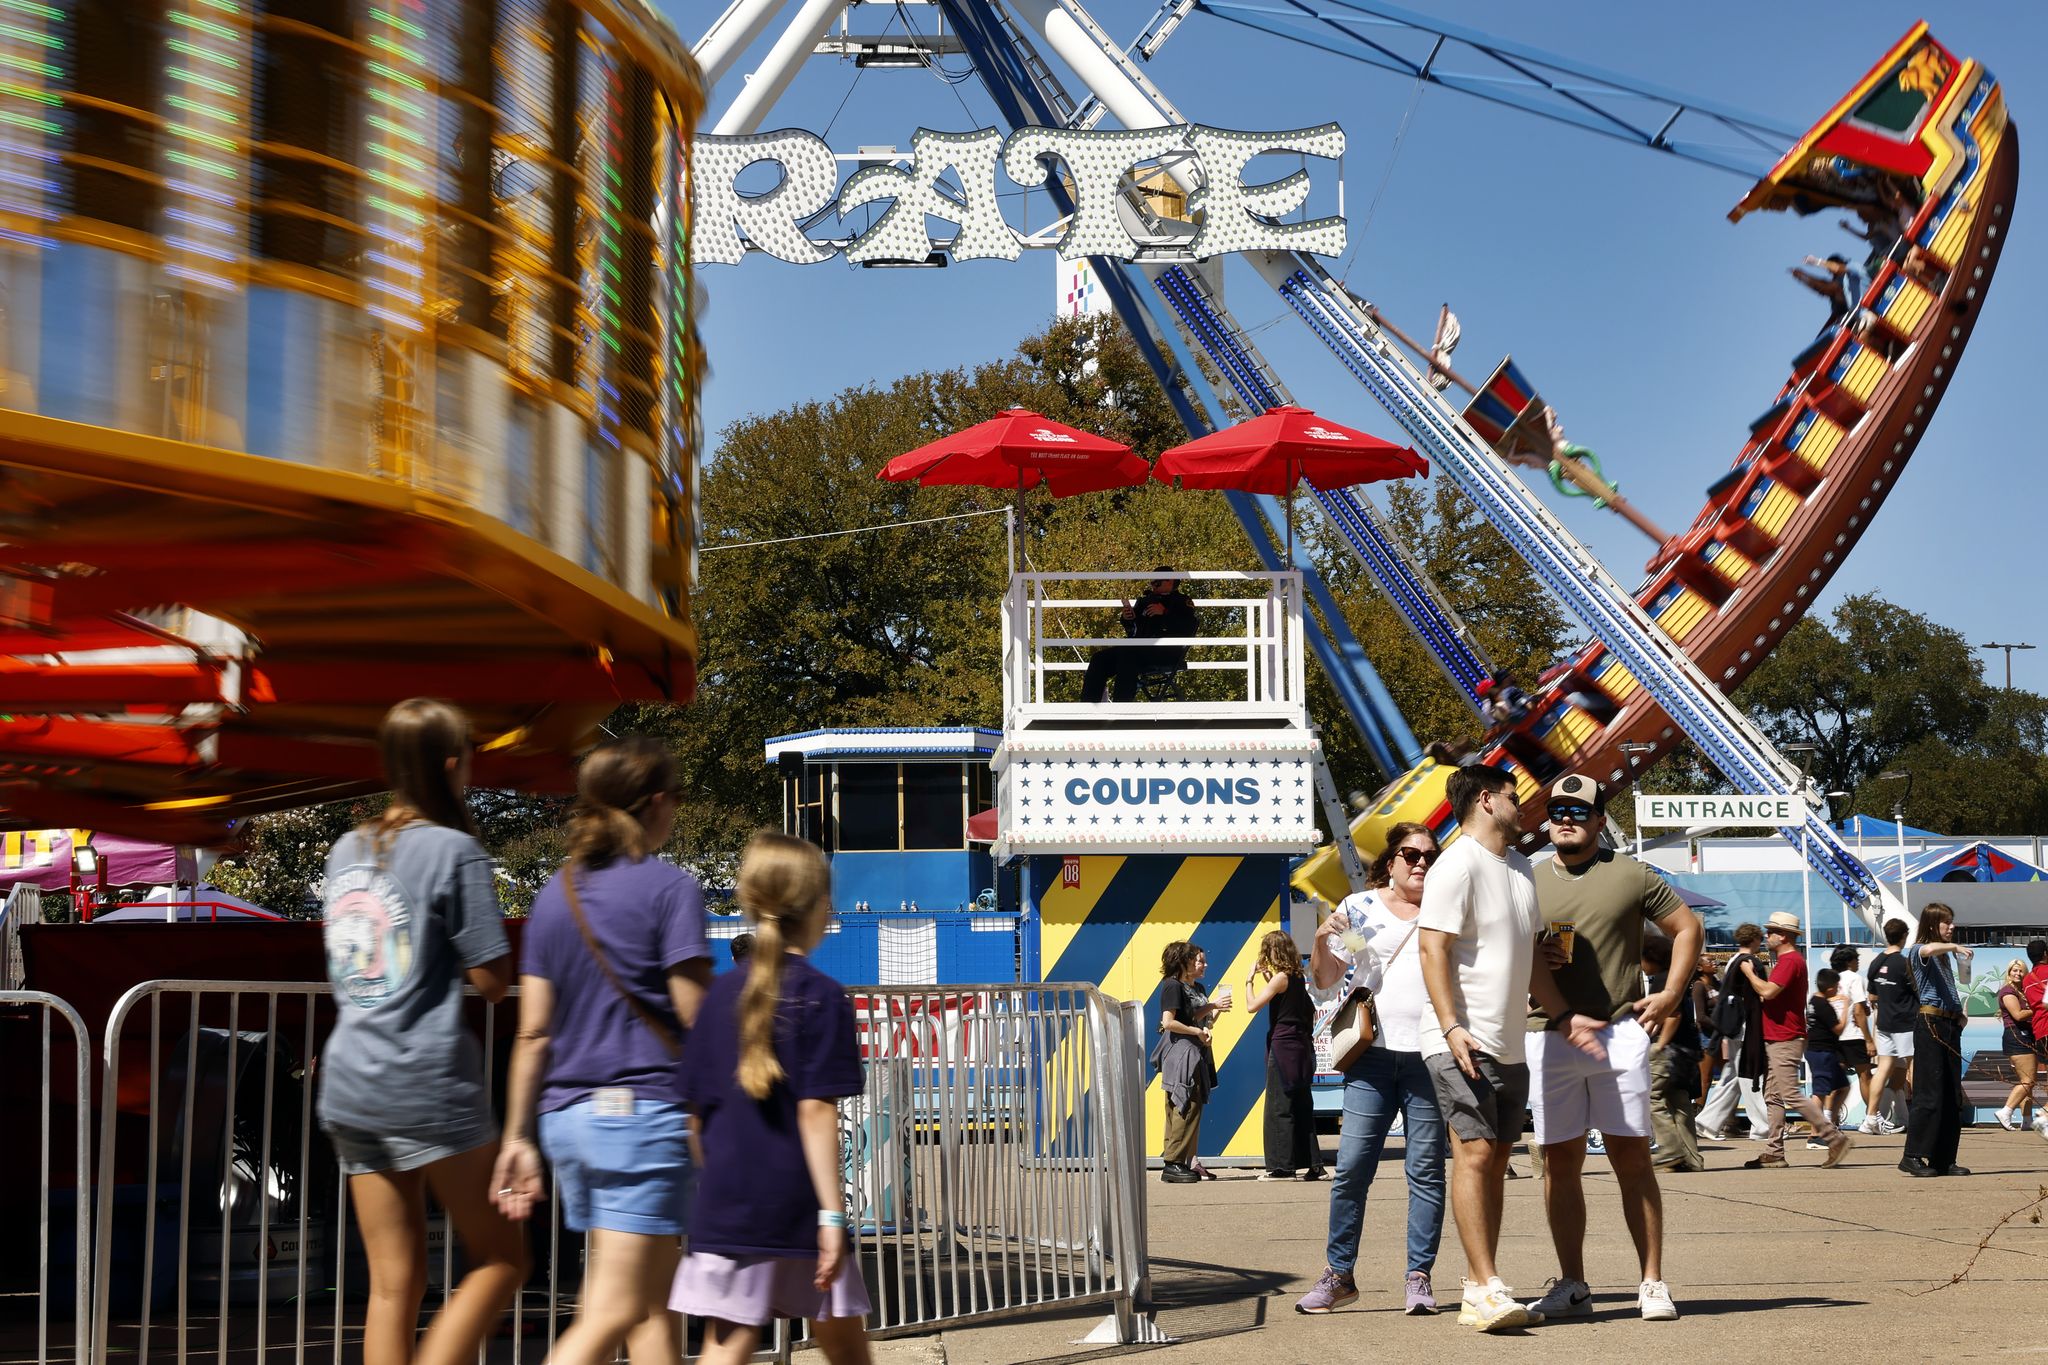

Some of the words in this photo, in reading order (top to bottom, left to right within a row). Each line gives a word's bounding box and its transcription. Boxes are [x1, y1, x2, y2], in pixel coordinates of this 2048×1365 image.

[1065, 777, 1260, 806] COUPONS
[1651, 801, 1791, 819] ENTRANCE
[1064, 864, 1079, 882] 08
